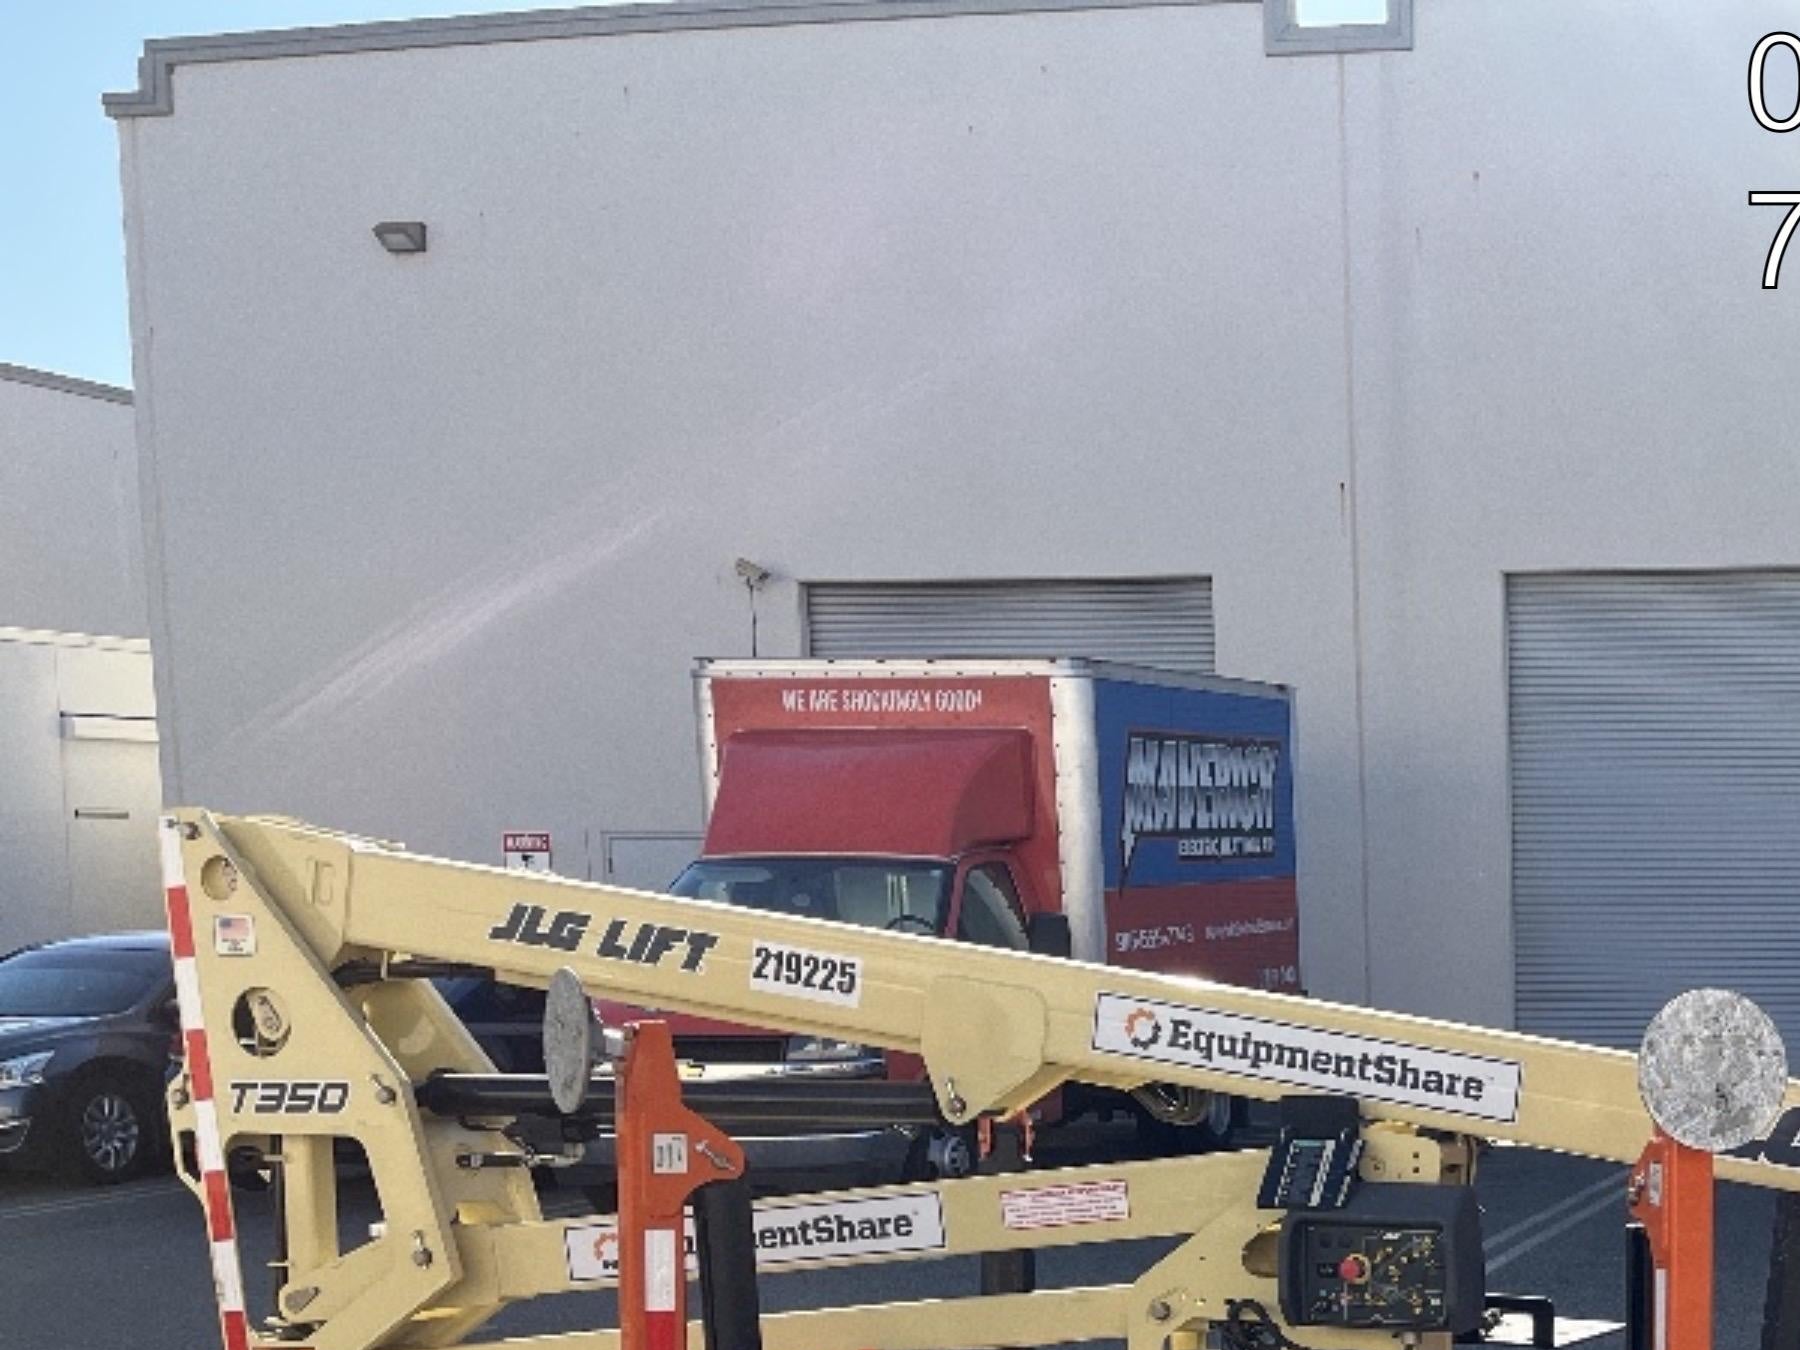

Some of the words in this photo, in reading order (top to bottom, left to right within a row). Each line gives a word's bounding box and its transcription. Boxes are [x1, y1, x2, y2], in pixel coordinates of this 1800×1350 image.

[489, 902, 591, 951] JLG
[597, 919, 719, 972] LIFT
[752, 946, 856, 995] 219225
[1167, 1017, 1484, 1101] EquipmentShare
[231, 1082, 349, 1114] T350
